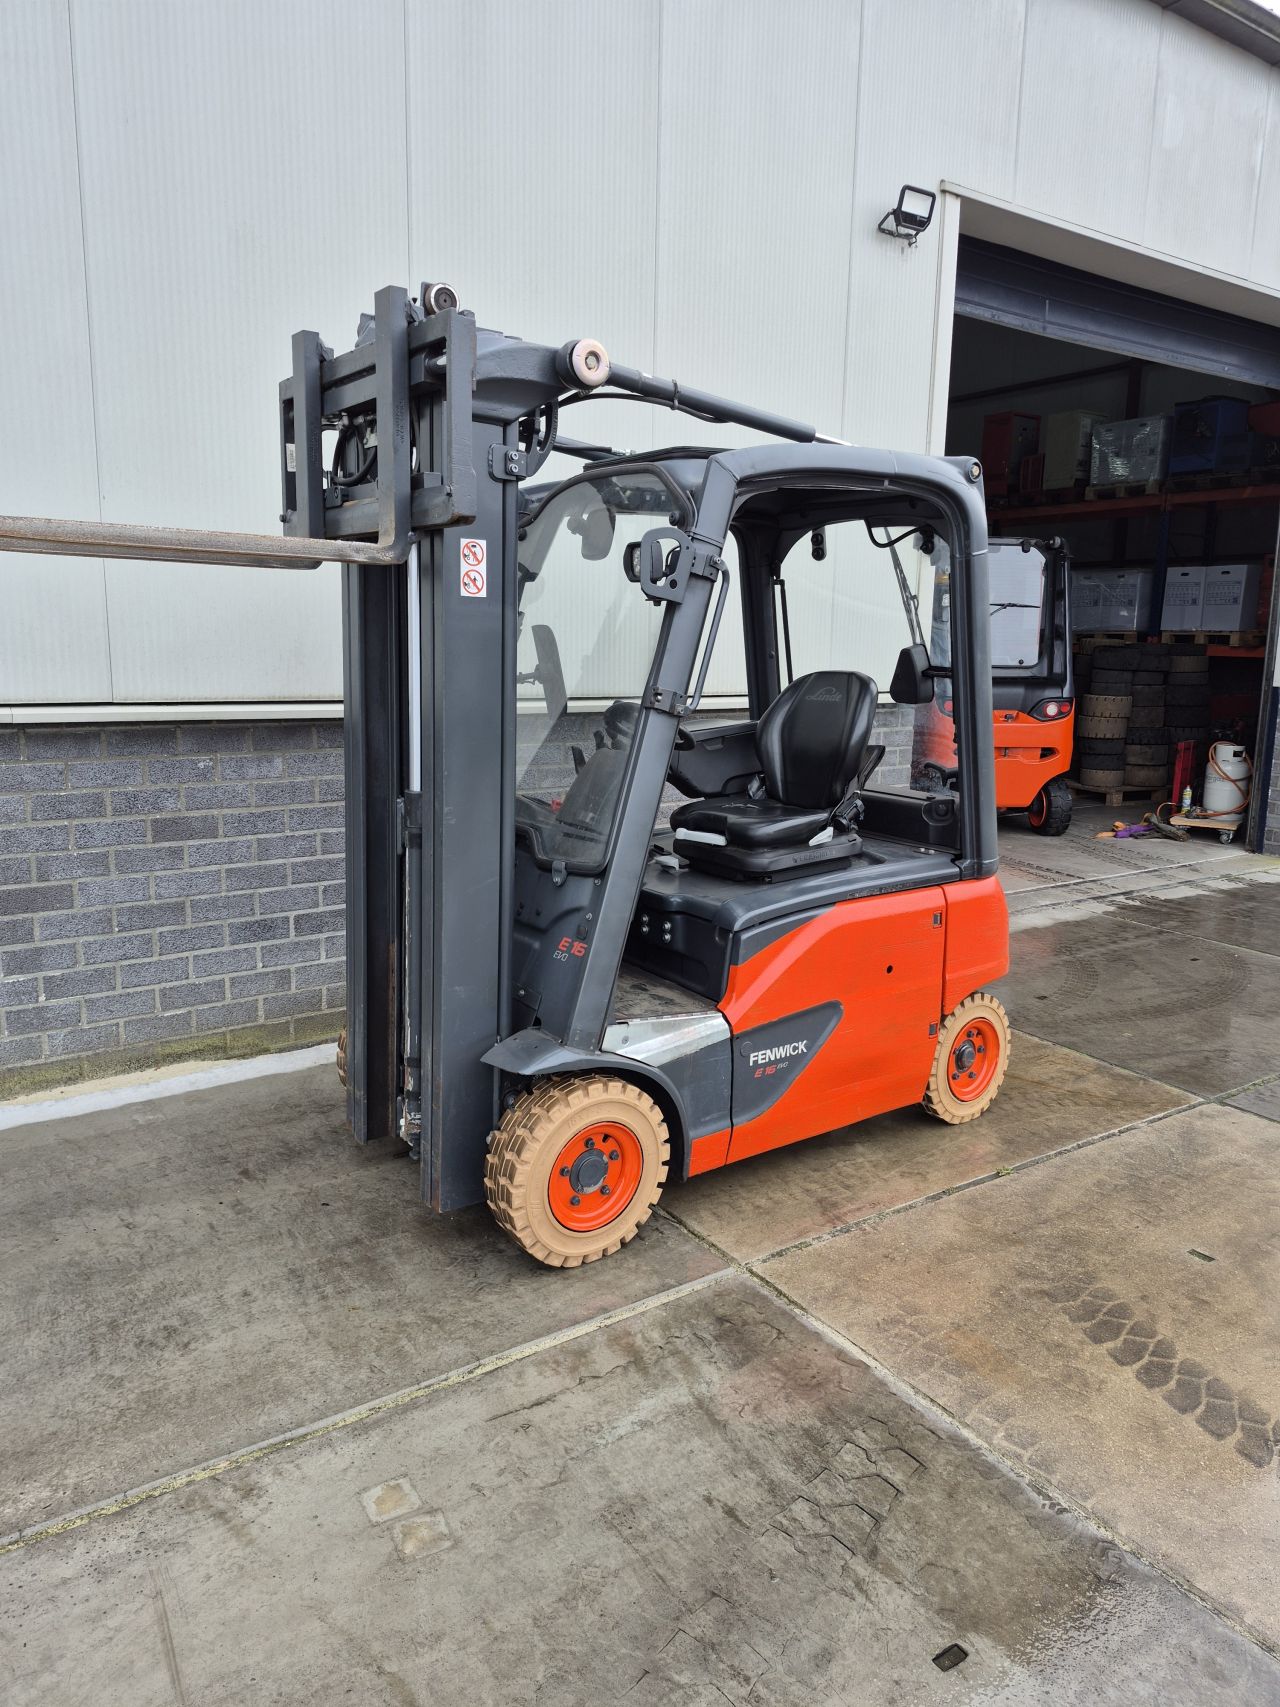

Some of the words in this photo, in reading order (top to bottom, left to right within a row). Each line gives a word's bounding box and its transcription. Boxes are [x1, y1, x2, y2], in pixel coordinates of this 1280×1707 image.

[553, 950, 568, 961] EVO
[559, 937, 572, 951] E
[570, 941, 588, 957] 16
[749, 1040, 807, 1066] FENWICK
[754, 1068, 763, 1078] E
[765, 1064, 777, 1075] 16
